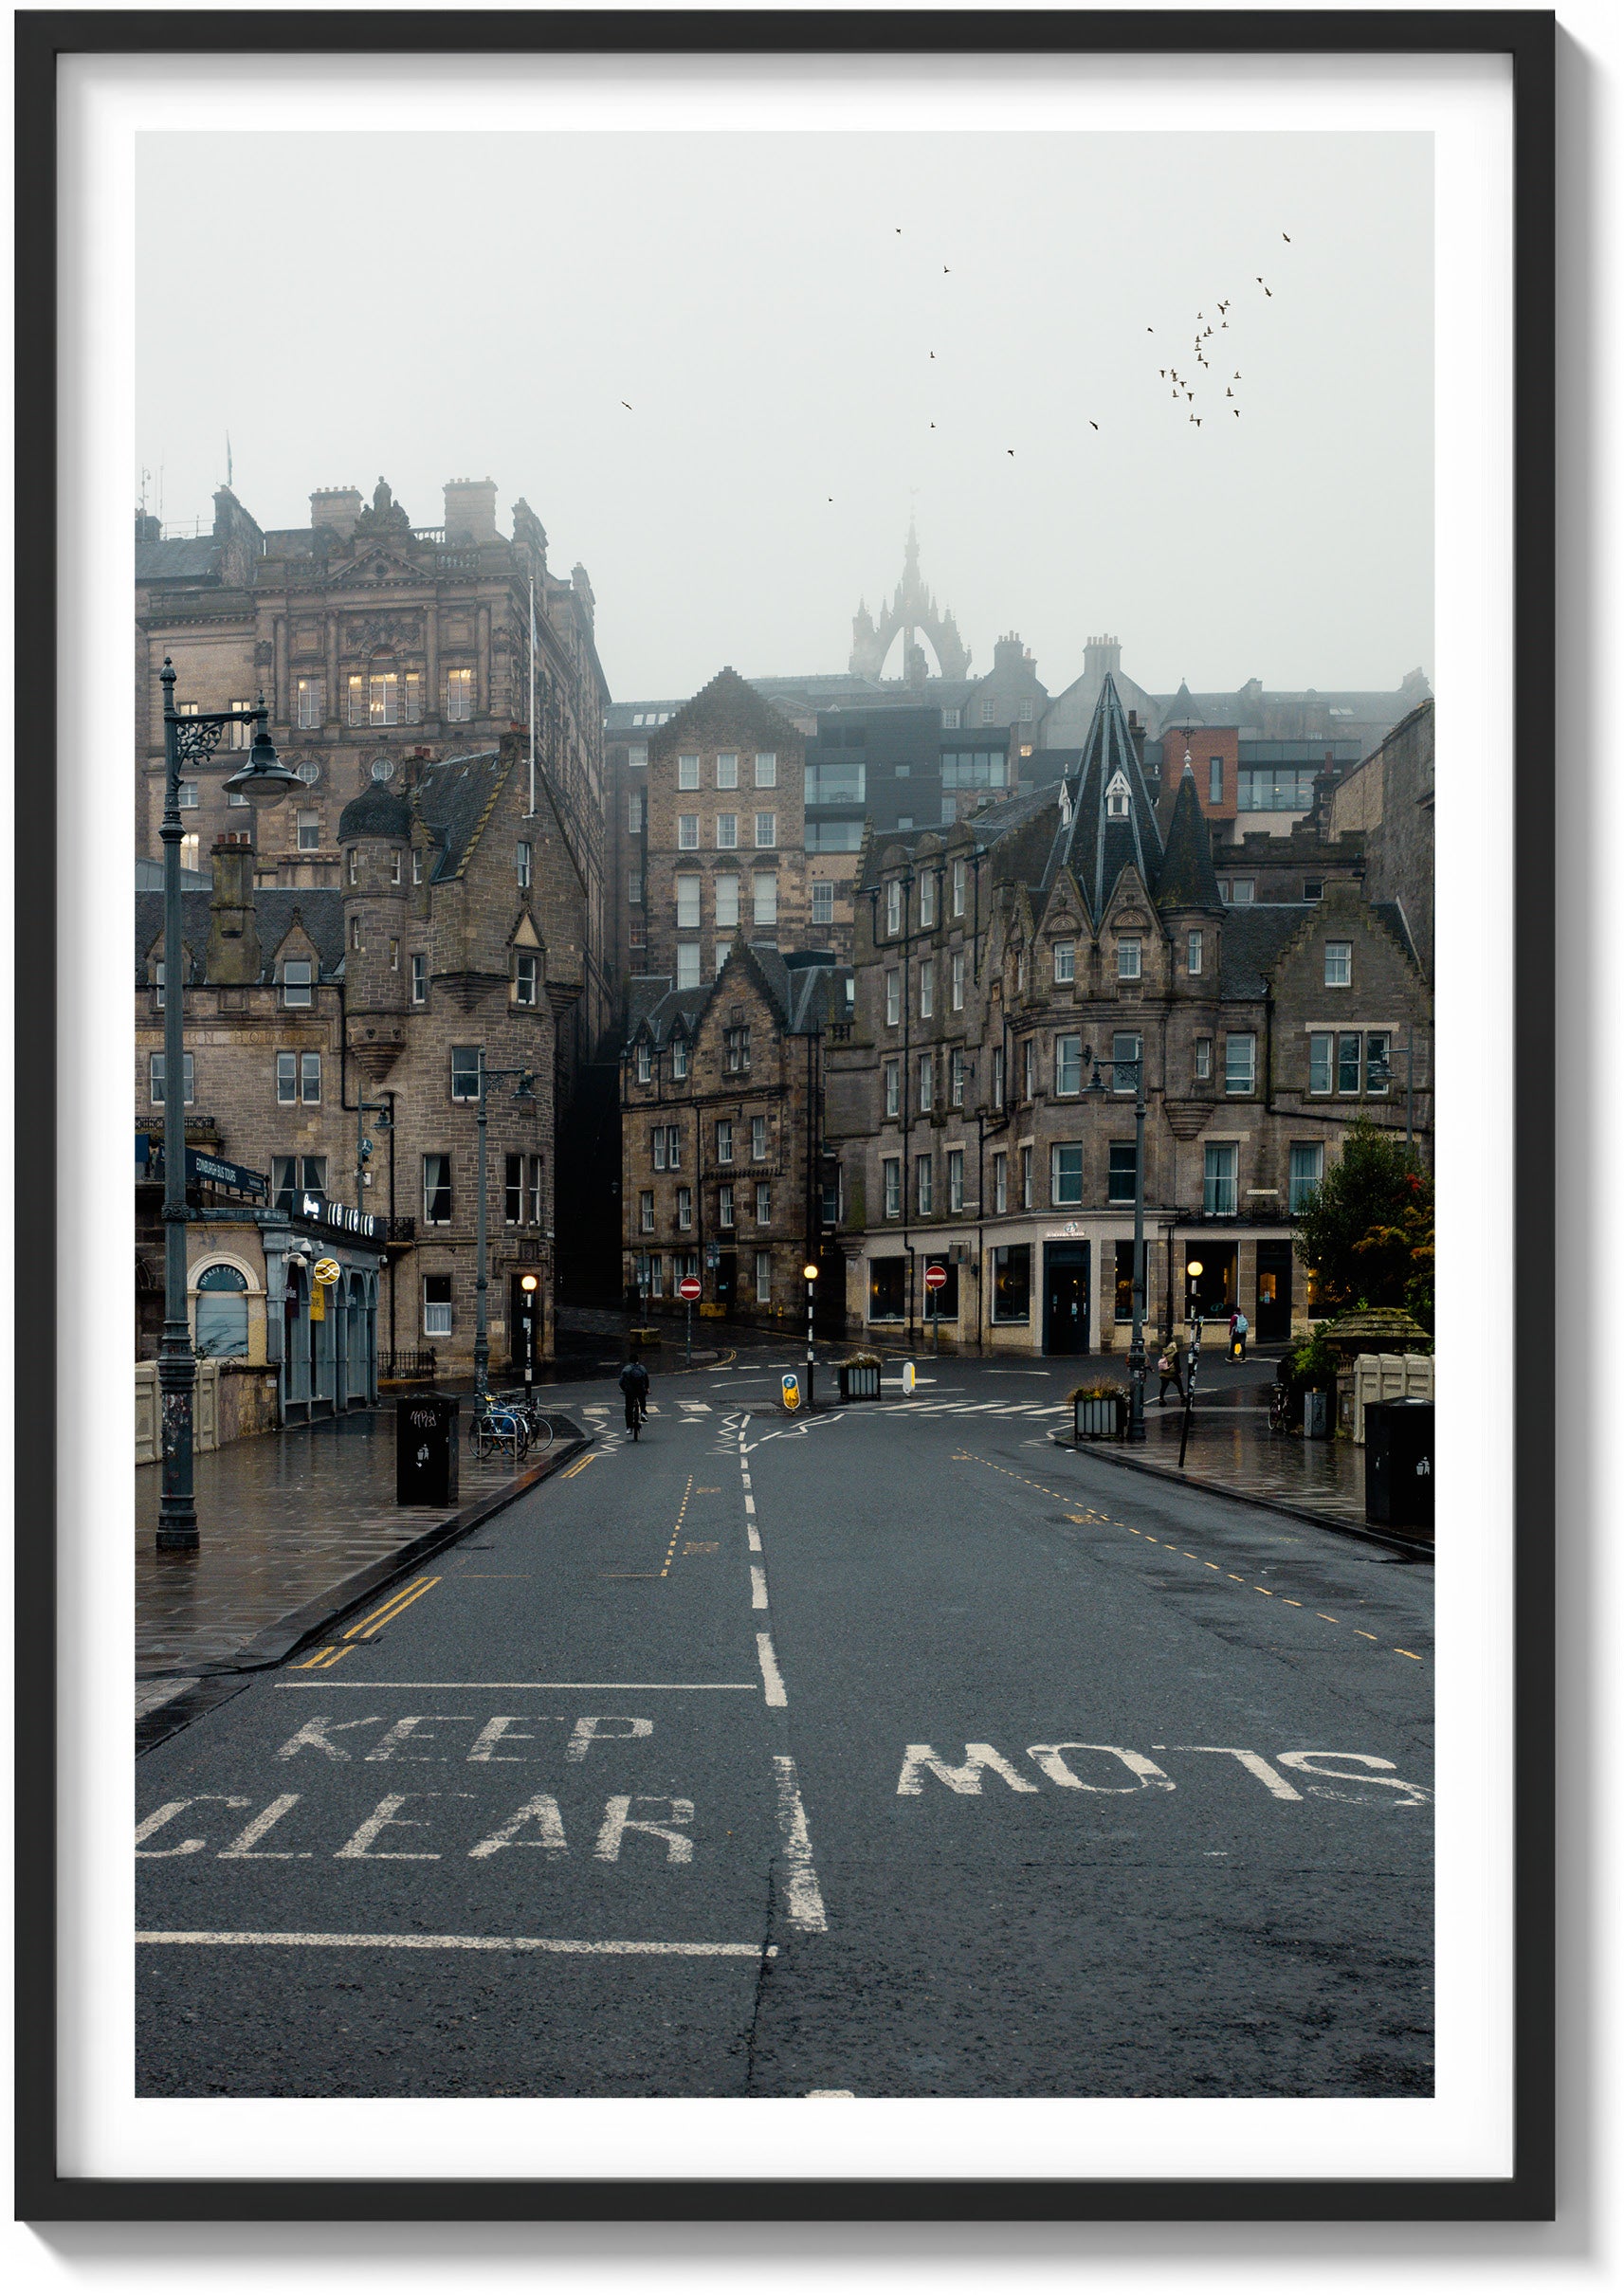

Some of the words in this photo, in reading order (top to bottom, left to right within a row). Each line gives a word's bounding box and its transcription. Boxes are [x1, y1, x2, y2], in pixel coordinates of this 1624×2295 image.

[196, 1157, 217, 1176] EDINBURGH
[225, 1167, 236, 1183] TOURS
[200, 1266, 220, 1286] TICKET
[223, 1266, 245, 1285] CENTRE
[274, 1715, 654, 1763] KEEP
[896, 1741, 1433, 1808] SLOW
[136, 1793, 695, 1865] CLEAR
